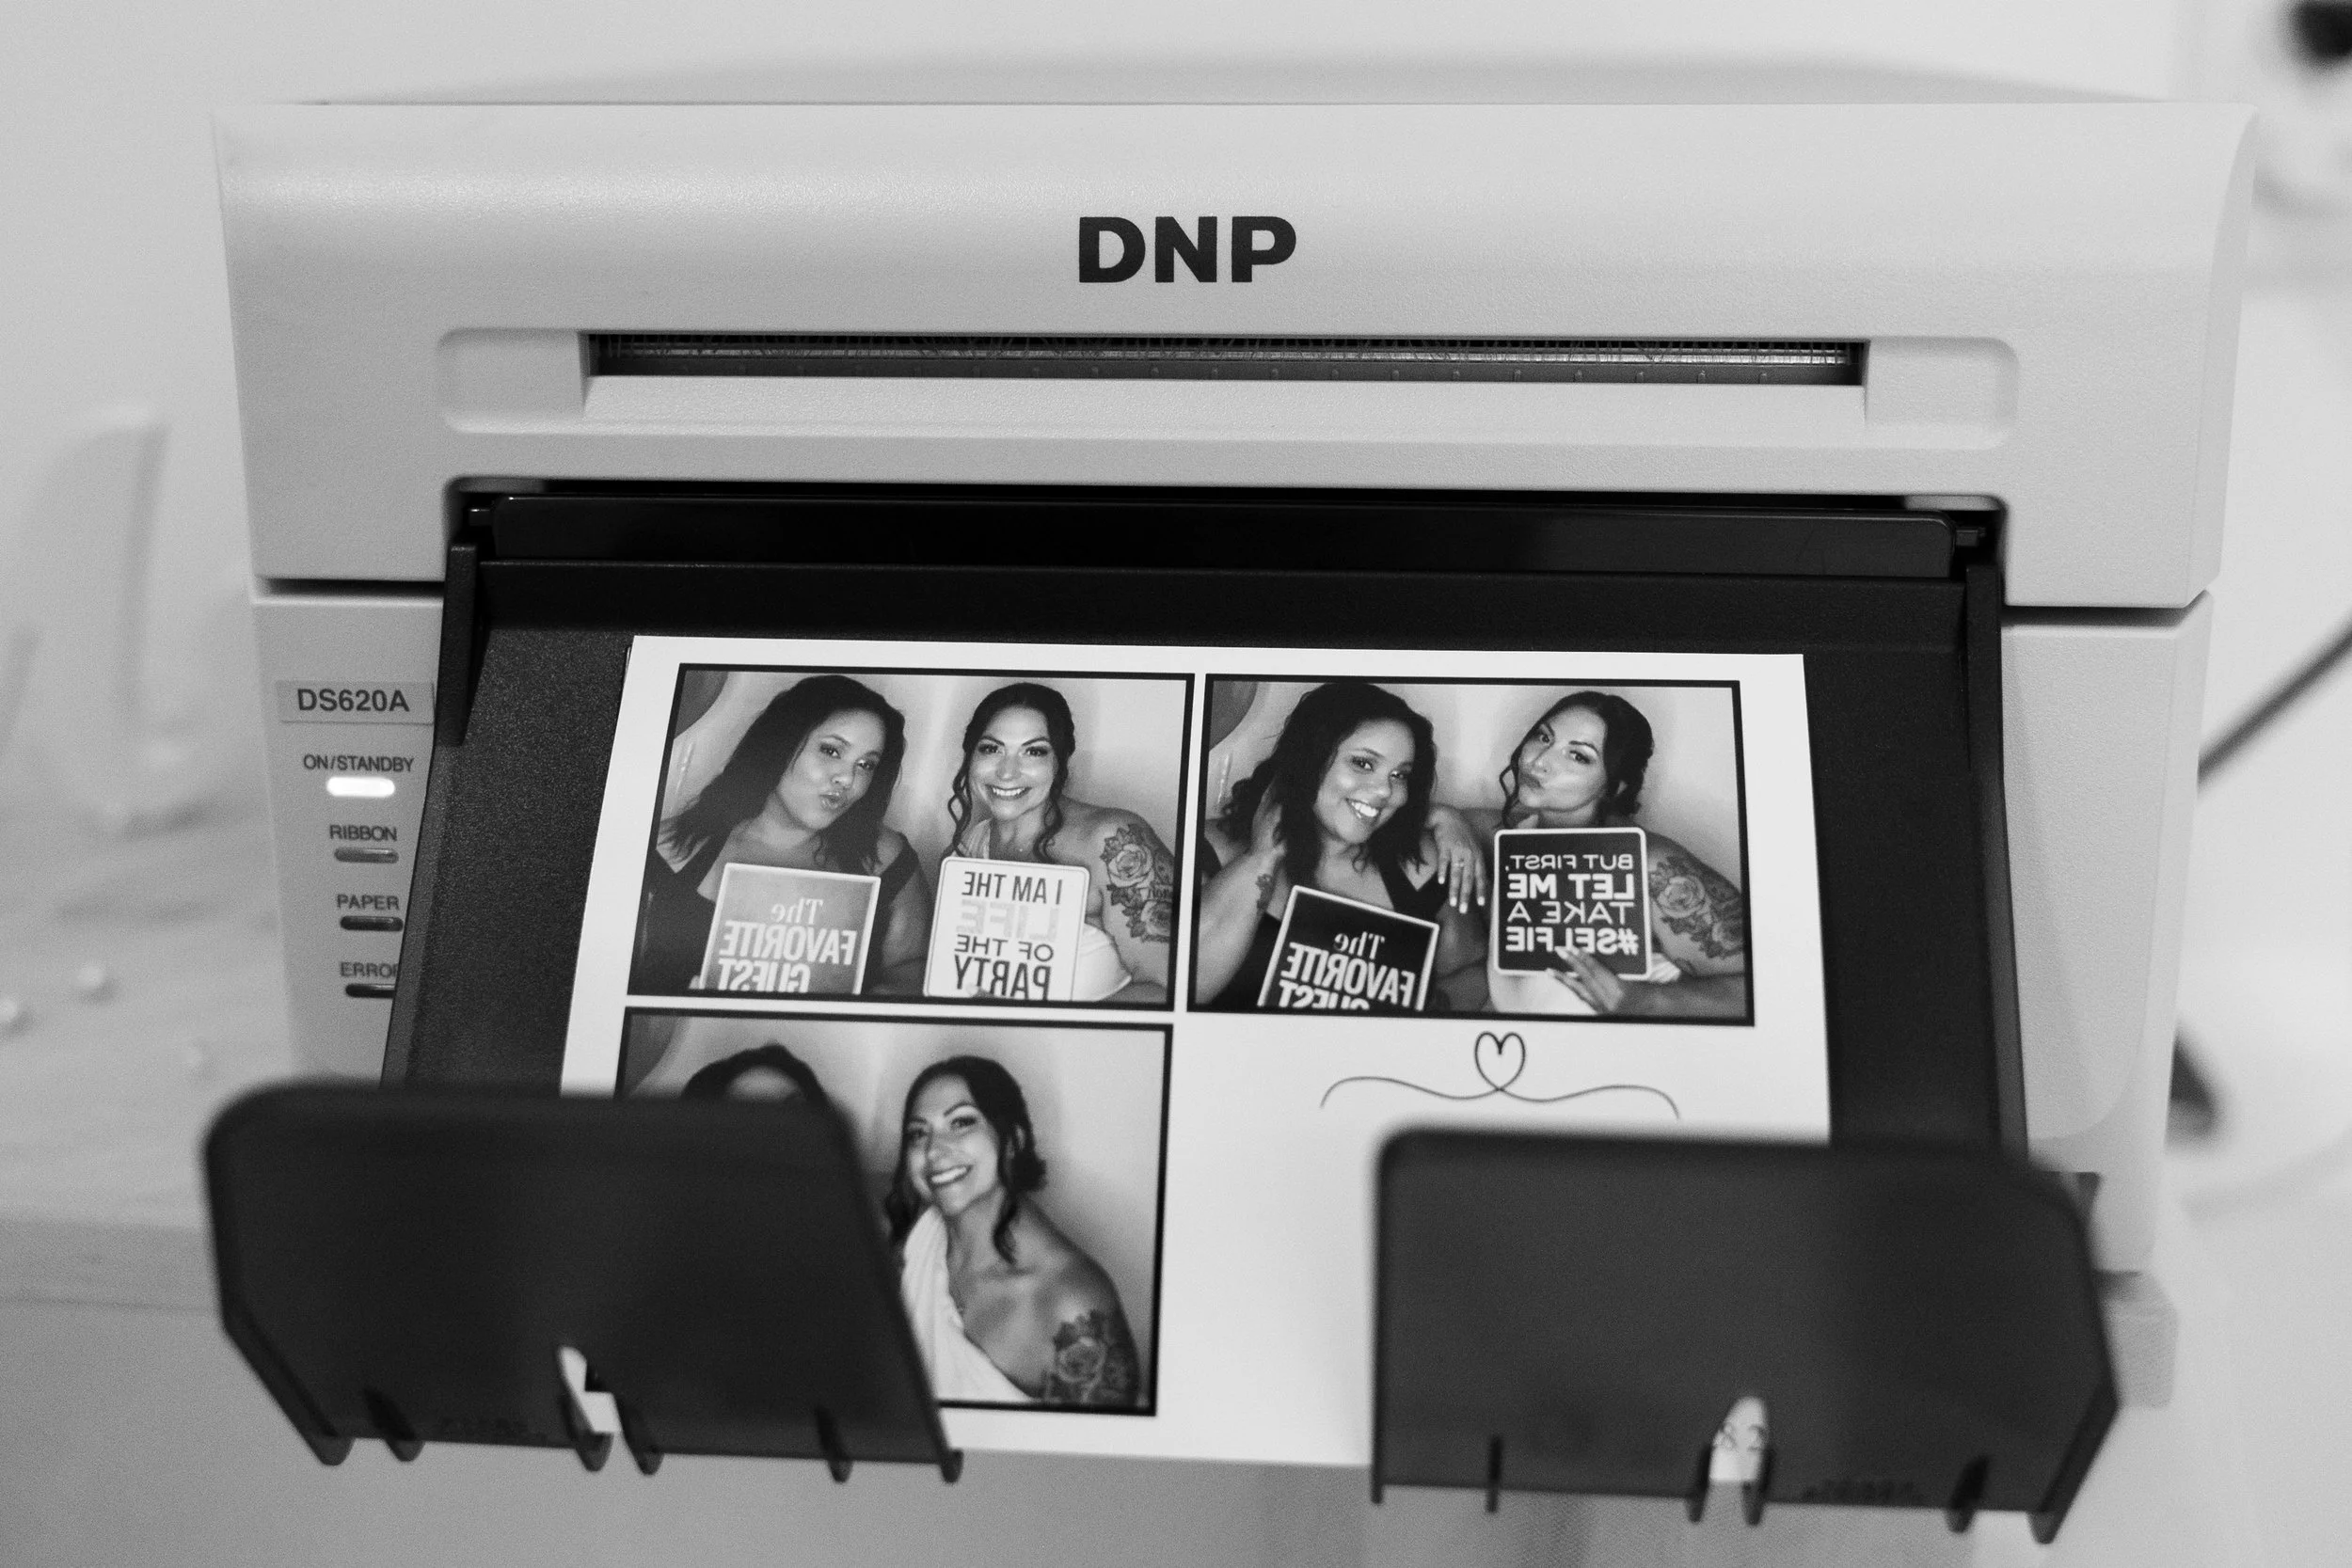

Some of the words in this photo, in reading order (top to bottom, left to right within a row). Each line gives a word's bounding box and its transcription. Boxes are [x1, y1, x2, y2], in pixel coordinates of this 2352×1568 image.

[1079, 216, 1296, 282] DNP
[297, 689, 410, 712] DS620A
[303, 754, 414, 772] ON/STANDBY
[329, 825, 398, 843] RIBBON
[336, 895, 400, 911] PAPER
